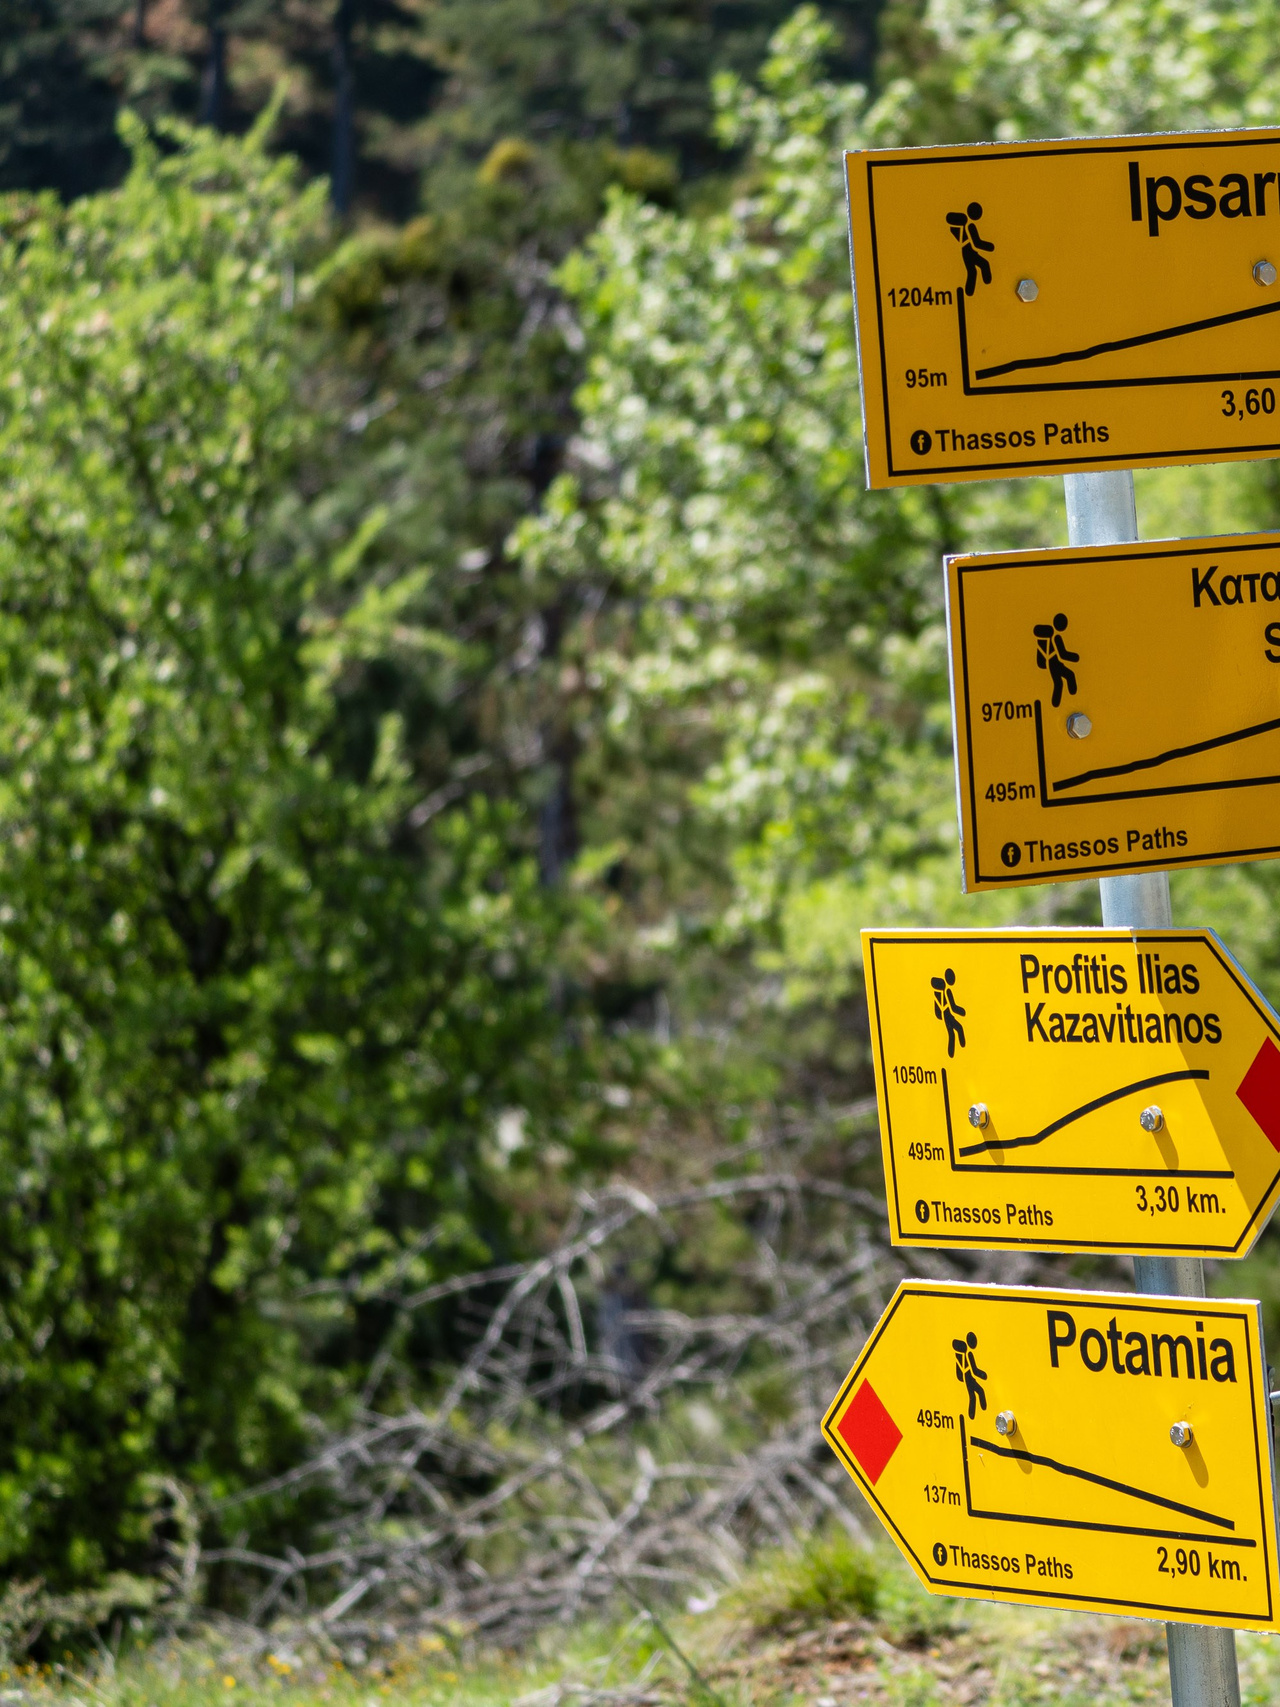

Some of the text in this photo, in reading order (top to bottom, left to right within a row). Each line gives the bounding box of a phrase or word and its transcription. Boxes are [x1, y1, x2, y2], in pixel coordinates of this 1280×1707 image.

[888, 287, 952, 307] 1204m
[906, 369, 947, 388] 95m
[1222, 388, 1275, 420] 3,60
[935, 429, 1035, 451] Thassos
[1044, 421, 1109, 445] Paths
[982, 701, 1033, 722] 970m
[985, 782, 1035, 802] 495m
[1024, 838, 1119, 863] Thassos
[1127, 827, 1187, 851] Paths
[1021, 954, 1199, 994] Profitis Ilias
[894, 1067, 936, 1083] 1050m
[909, 1143, 944, 1160] 495m
[1136, 1186, 1225, 1215] 3,30 km.
[932, 1202, 1000, 1223] Thassos
[1007, 1204, 1052, 1225] Paths
[1047, 1310, 1237, 1382] Potamia
[918, 1410, 953, 1428] 495m
[925, 1485, 960, 1505] 137m
[950, 1546, 1019, 1572] Thassos
[1026, 1554, 1072, 1578] Paths
[1158, 1547, 1248, 1581] 2,90 km.
